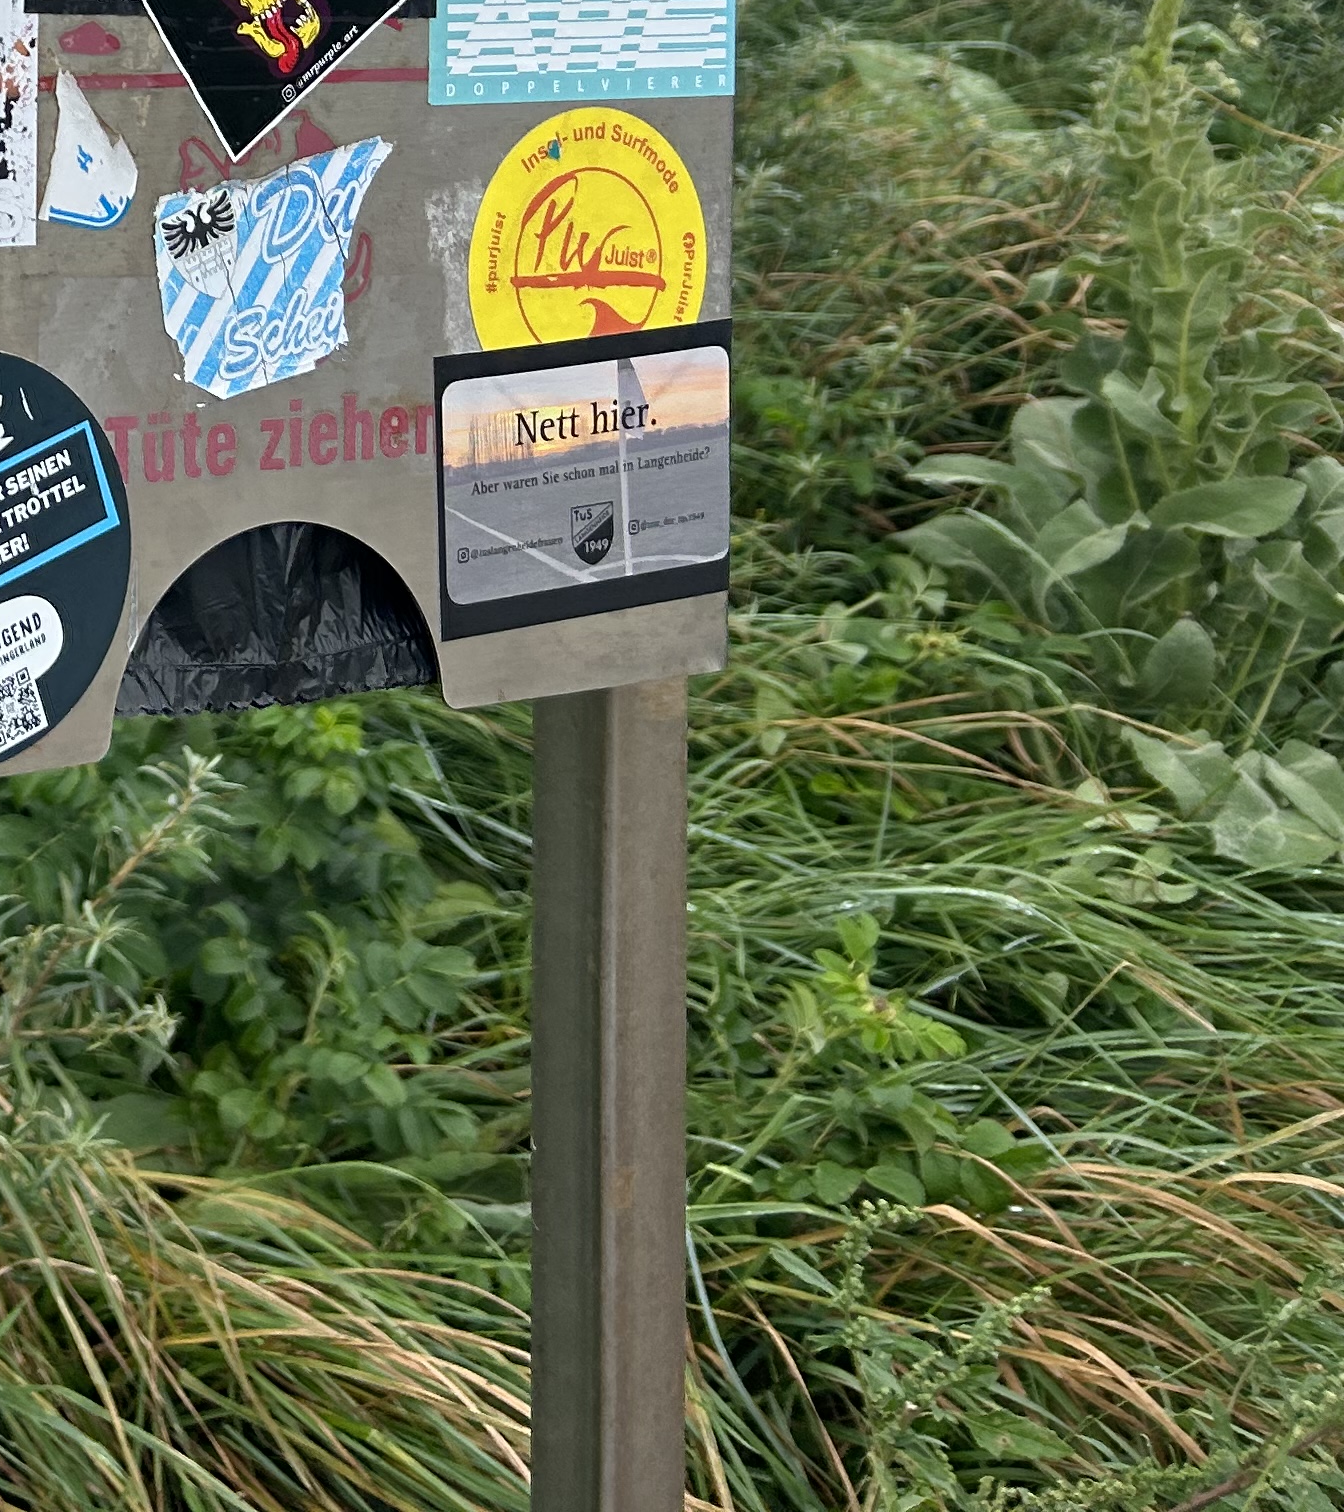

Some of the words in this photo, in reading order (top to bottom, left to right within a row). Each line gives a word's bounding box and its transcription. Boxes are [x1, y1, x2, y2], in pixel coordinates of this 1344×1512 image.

[296, 25, 359, 88] @mrpurple_art
[446, 74, 727, 97] DOPPELVIERER
[573, 122, 605, 143] und
[610, 123, 679, 194] Surfmode
[486, 211, 506, 294] #purjuist
[105, 410, 237, 483] Tüte
[514, 406, 580, 446] Nett
[590, 398, 657, 435] hier.
[6, 449, 72, 495] SEINEN
[471, 479, 498, 496] Aber
[503, 476, 539, 489] waren
[542, 471, 560, 485] Sie
[563, 466, 595, 482] schon
[599, 460, 620, 476] mal
[623, 460, 634, 472] in
[637, 446, 711, 470] Langenheide?
[1, 475, 86, 528] TROTTEL
[573, 508, 593, 522] TuS
[584, 538, 609, 553] 1949
